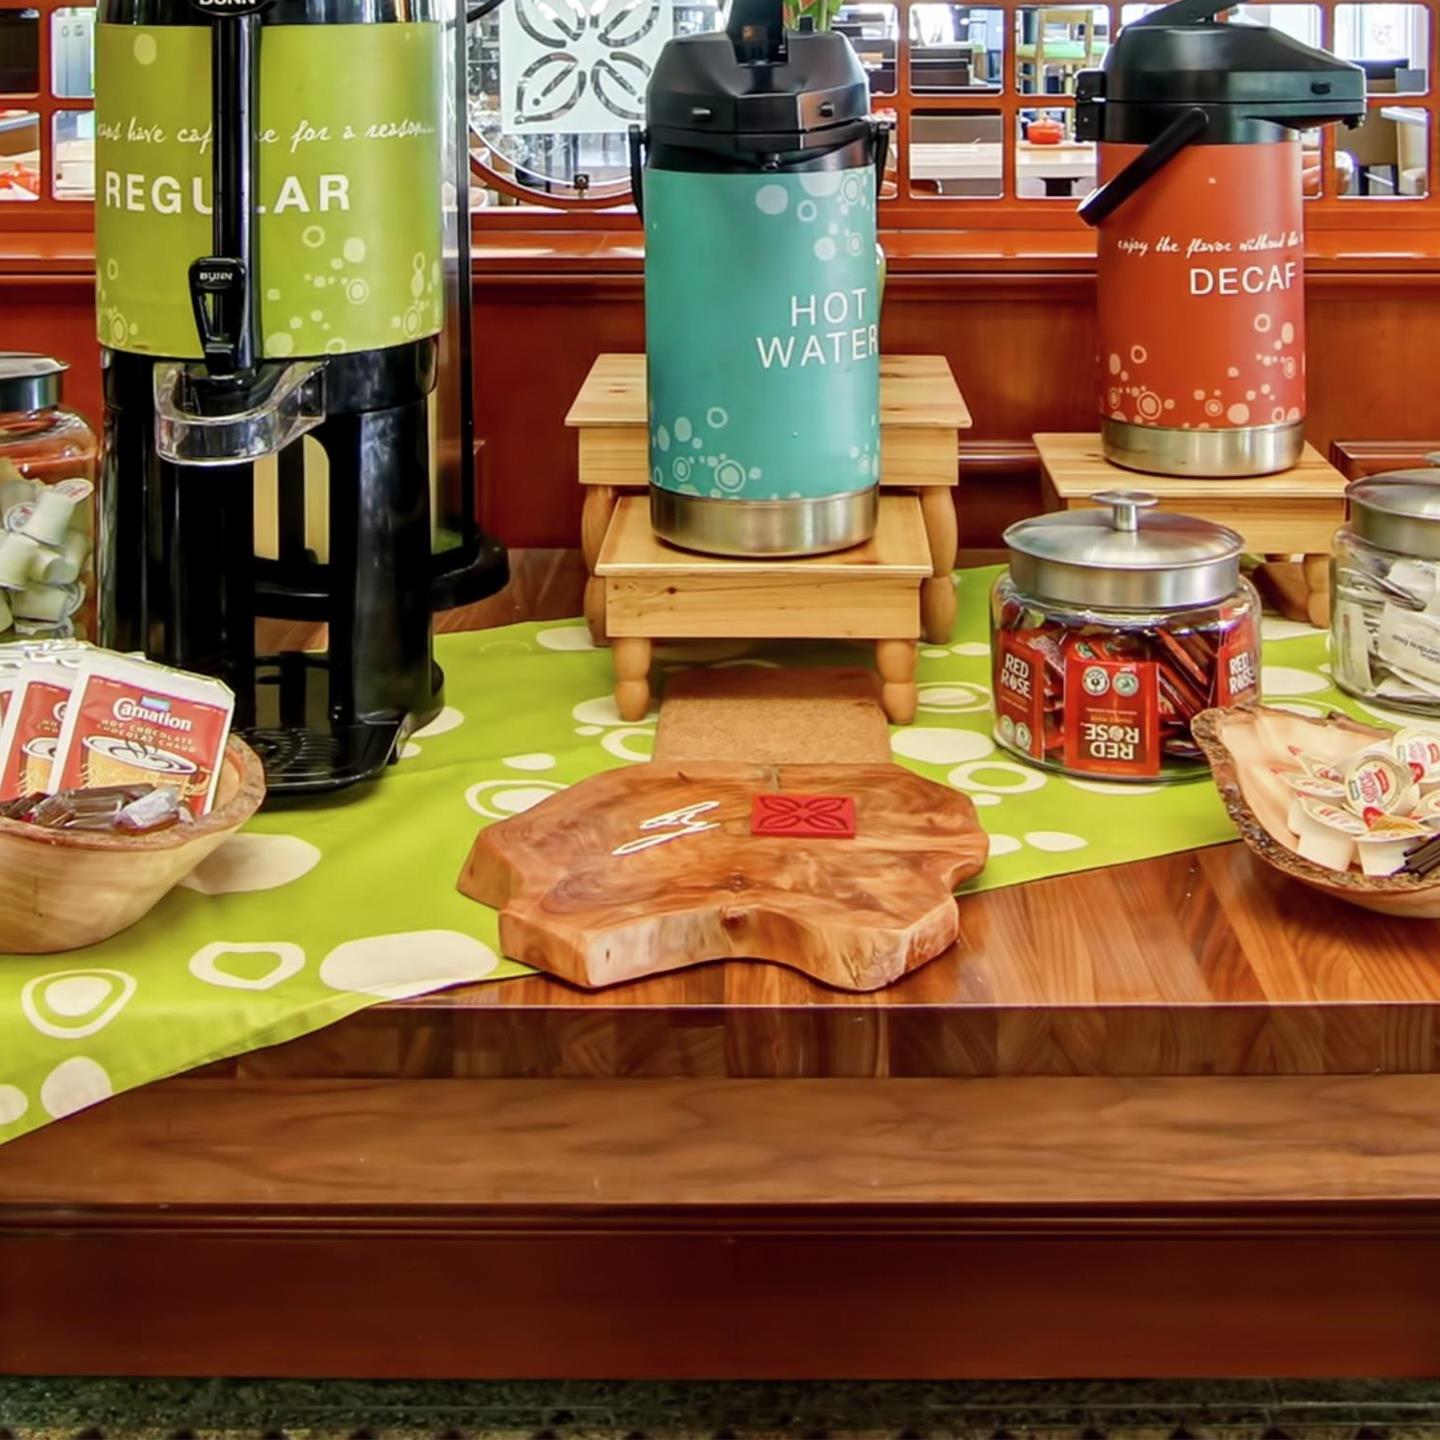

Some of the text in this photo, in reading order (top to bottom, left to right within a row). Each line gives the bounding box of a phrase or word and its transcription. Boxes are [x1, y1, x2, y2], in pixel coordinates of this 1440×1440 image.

[127, 116, 168, 143] have
[291, 120, 331, 154] for
[343, 125, 356, 140] a
[105, 171, 350, 216] REGUAR
[1156, 235, 1180, 253] the
[1190, 262, 1296, 295] DECAF
[791, 288, 867, 327] HOT
[757, 323, 878, 369] WATER
[1005, 653, 1029, 679] RED
[1001, 668, 1032, 699] ROSE
[1083, 722, 1140, 744] ROSE
[1089, 741, 1134, 760] RED
